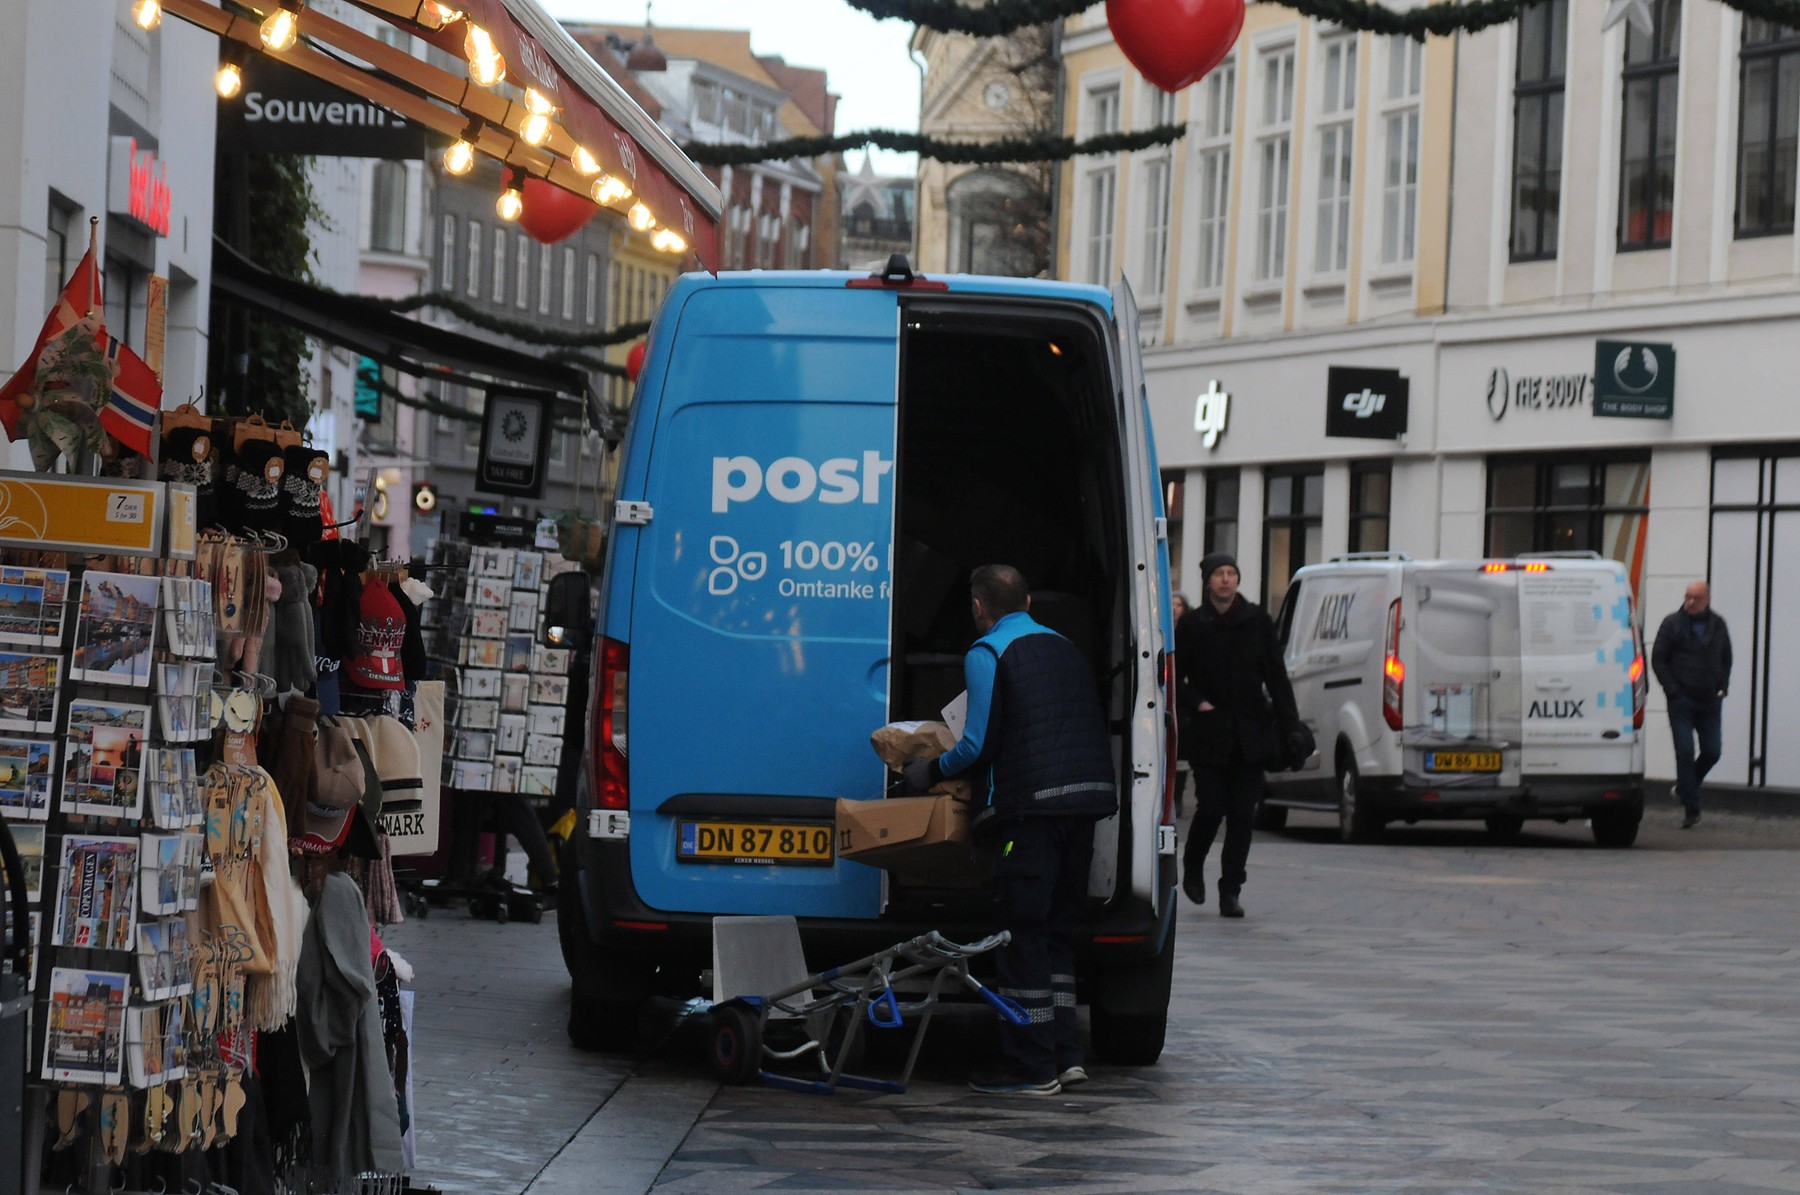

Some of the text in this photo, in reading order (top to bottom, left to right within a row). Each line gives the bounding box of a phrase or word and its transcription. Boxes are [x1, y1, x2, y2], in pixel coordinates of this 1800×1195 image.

[244, 92, 408, 128] Souvenirs
[1602, 402, 1618, 412] THE
[1620, 403, 1643, 413] BODY
[116, 495, 127, 510] 7
[779, 540, 879, 572] 100%
[778, 578, 874, 599] Omtanke
[1528, 700, 1584, 718] ALUX
[682, 841, 693, 850] DK
[700, 828, 828, 854] DN 87 810
[81, 853, 96, 918] COPENHAGEN
